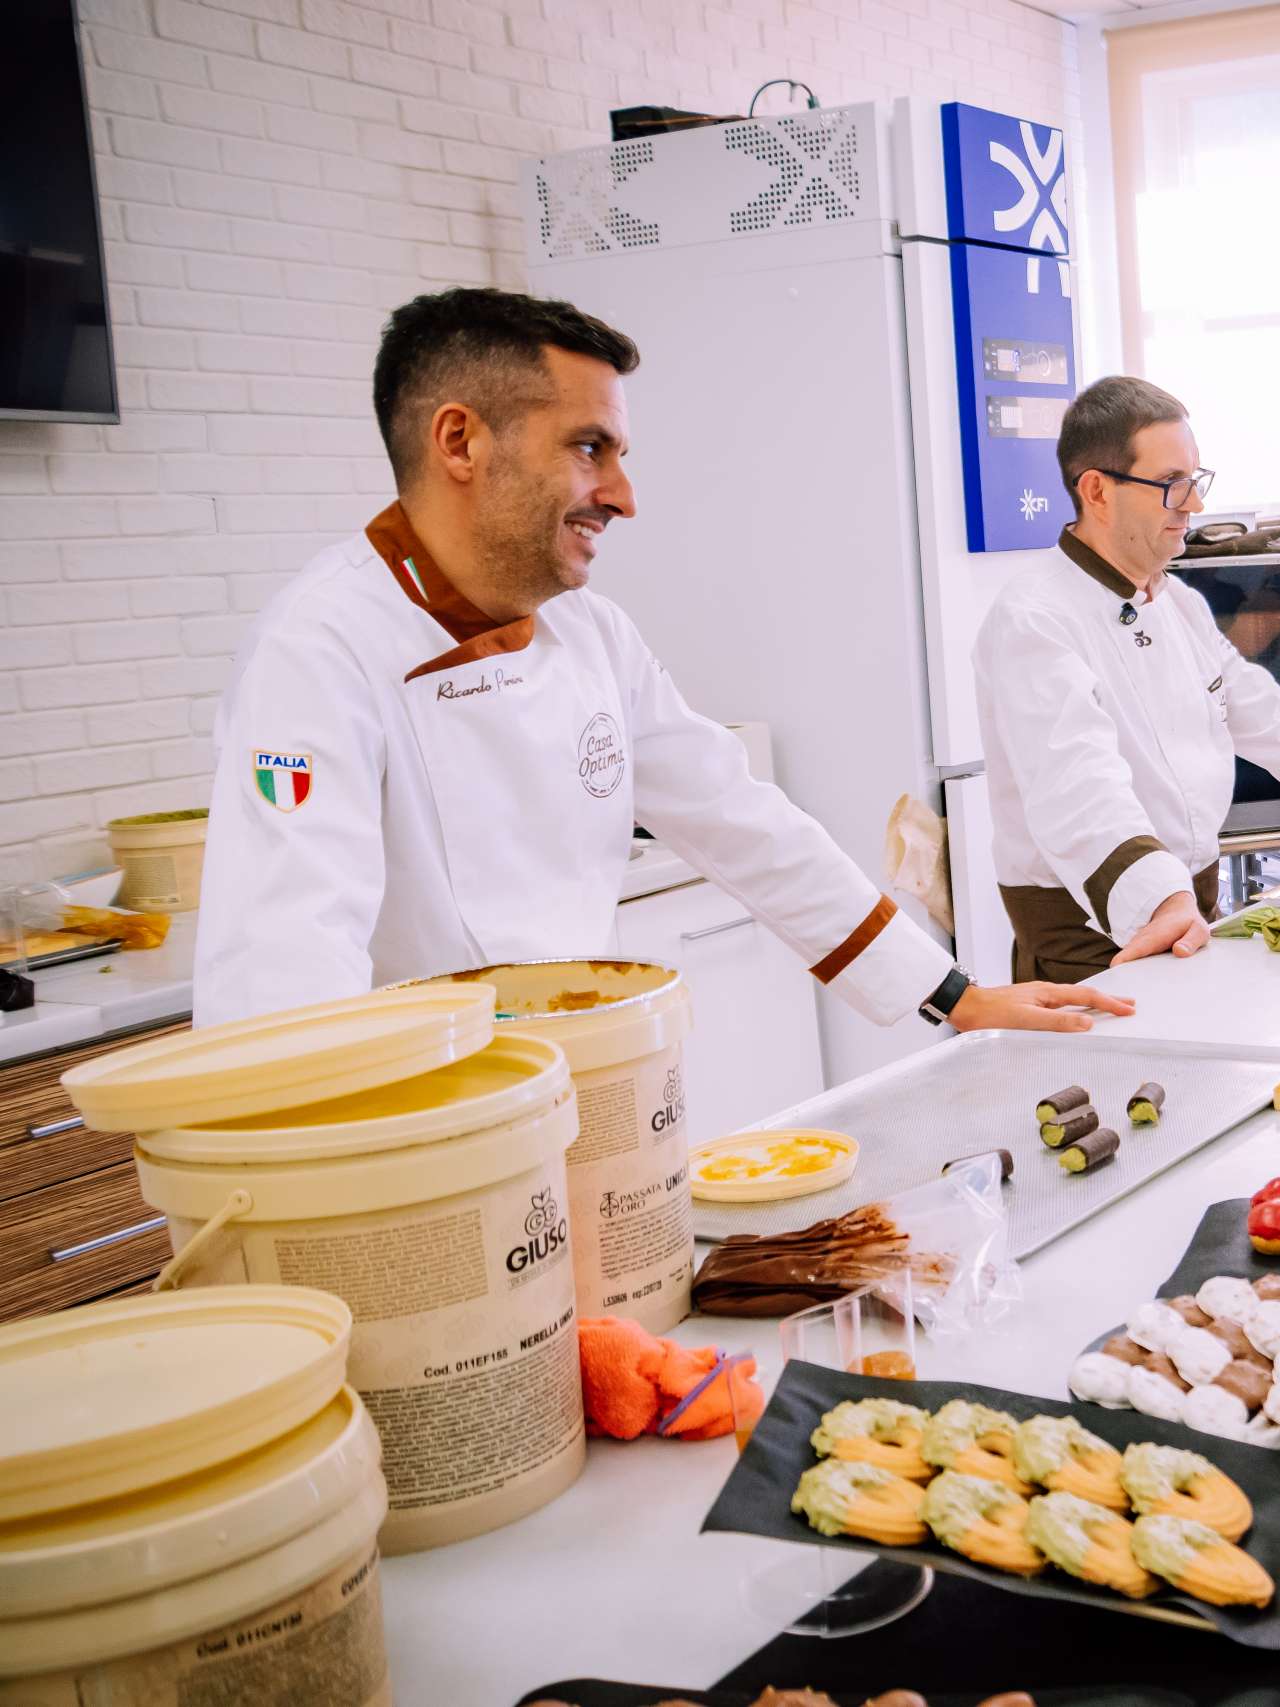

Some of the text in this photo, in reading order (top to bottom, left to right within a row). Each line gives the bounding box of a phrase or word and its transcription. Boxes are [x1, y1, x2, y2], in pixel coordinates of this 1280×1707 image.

[437, 675, 492, 701] Ricardo
[587, 733, 613, 755] Casa
[258, 754, 308, 769] ITALIA
[579, 750, 625, 780] Optima
[506, 1218, 567, 1273] GIUSO
